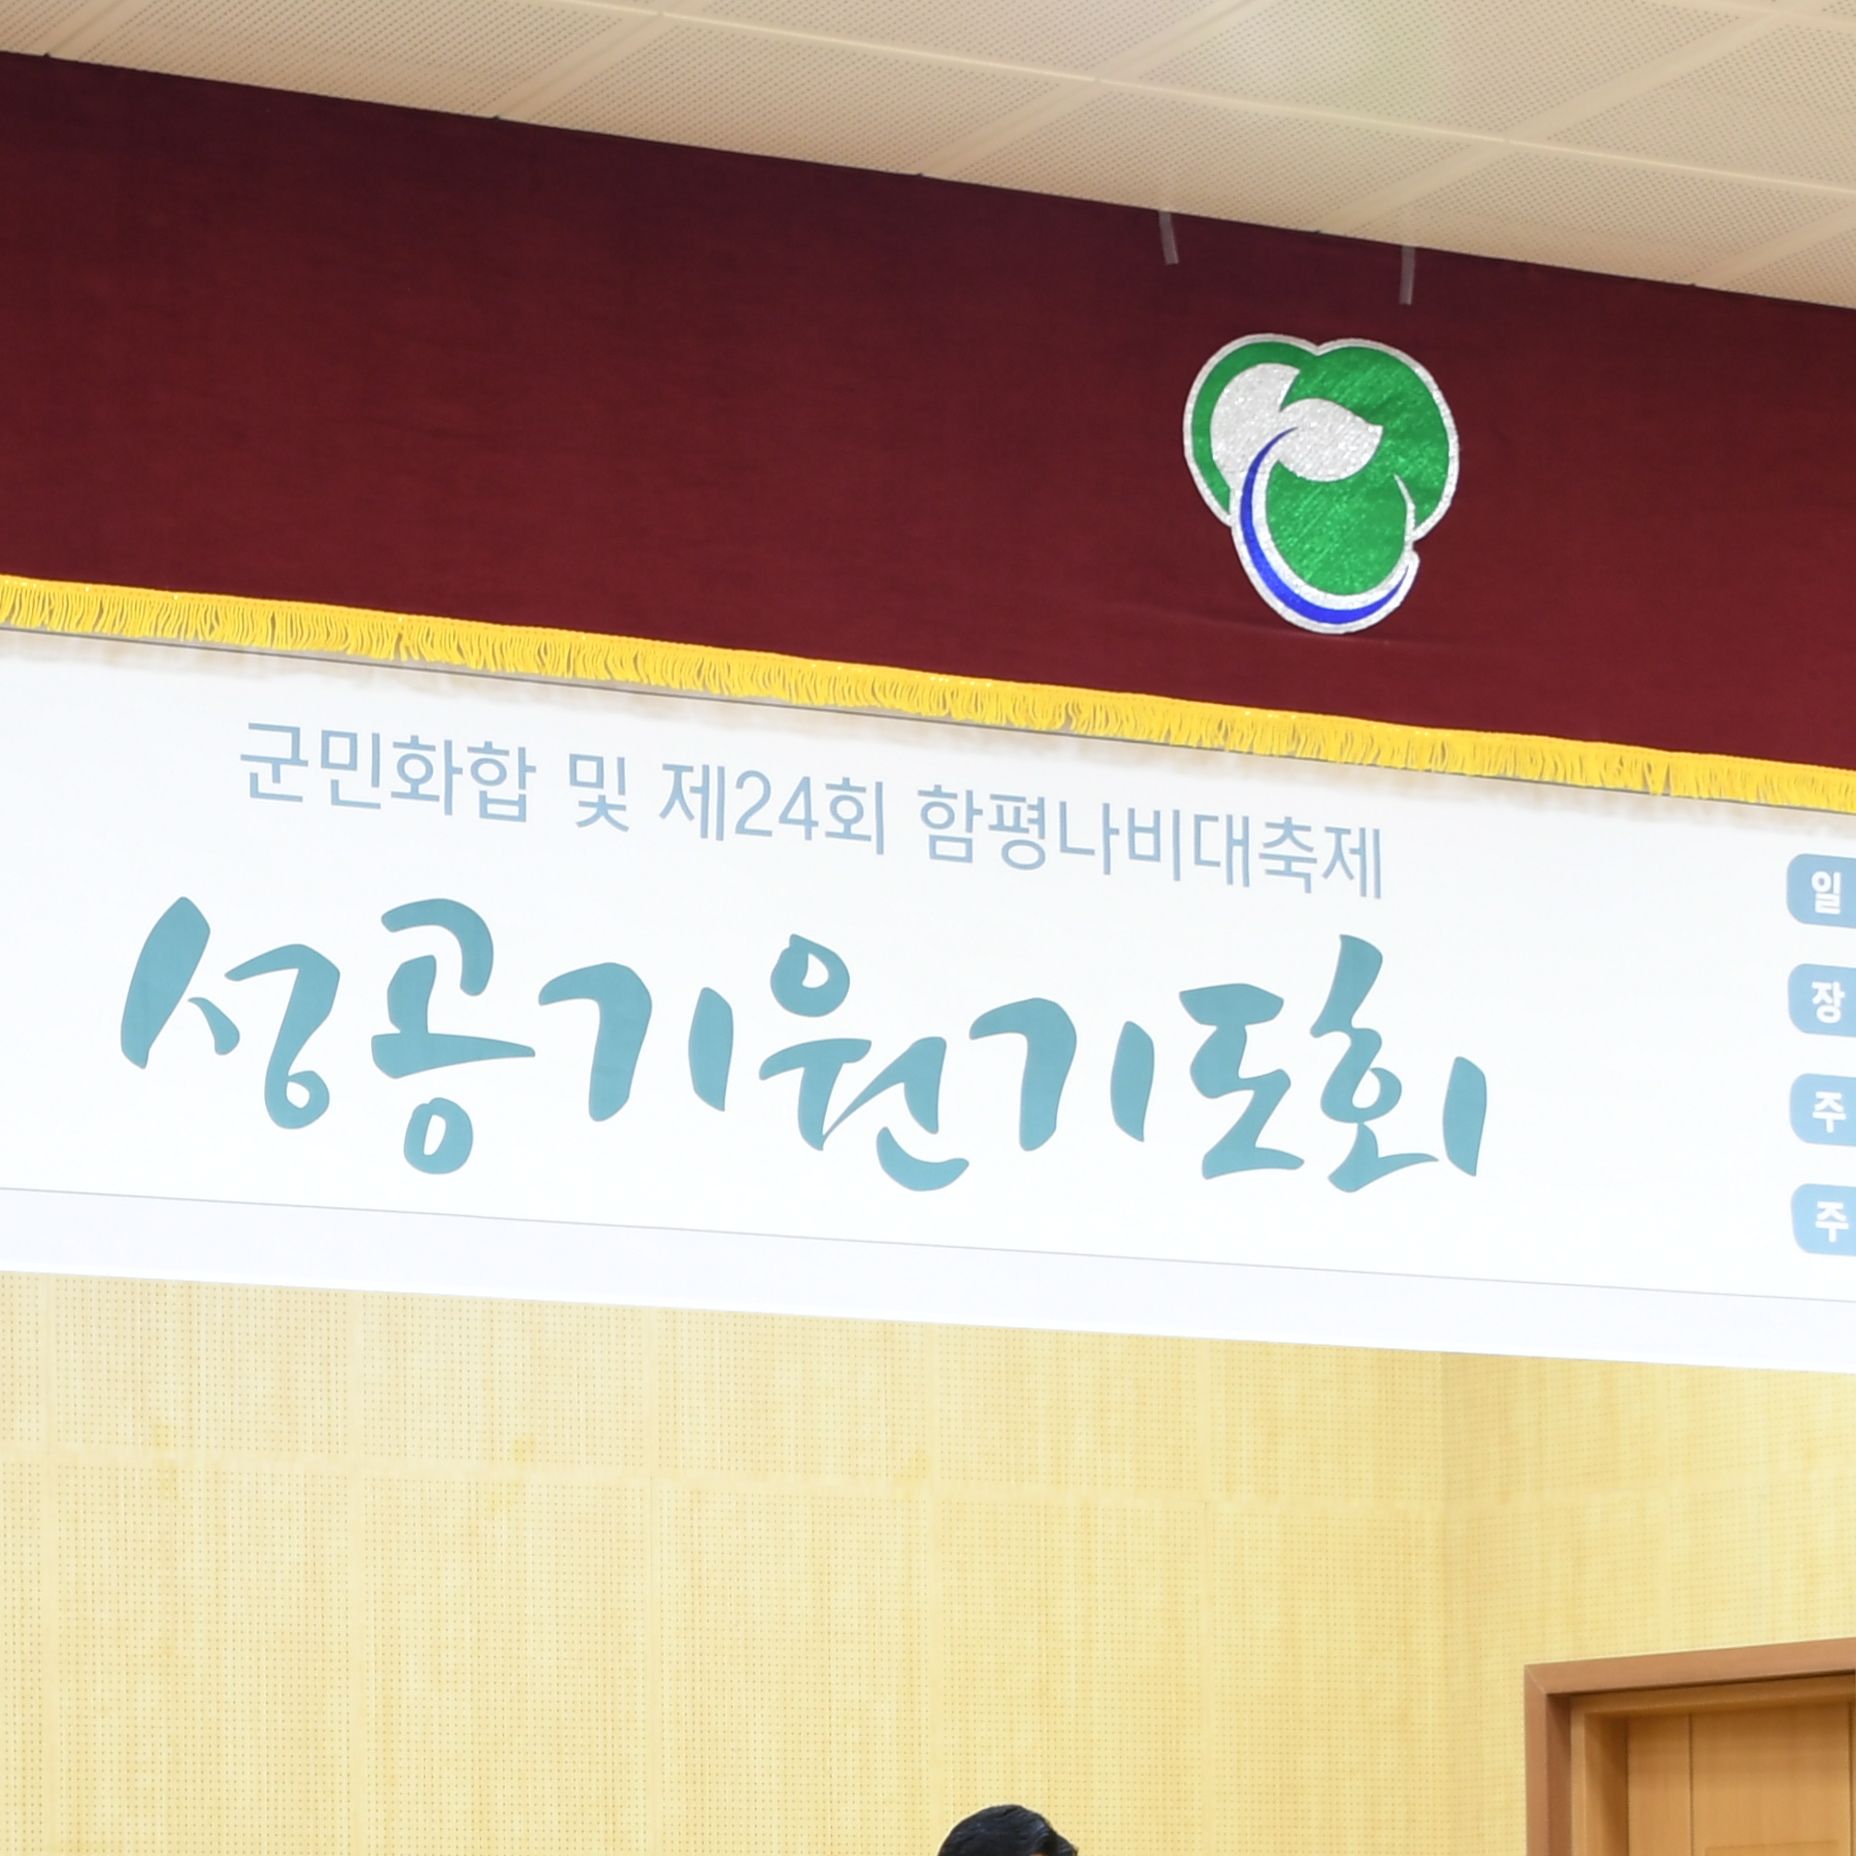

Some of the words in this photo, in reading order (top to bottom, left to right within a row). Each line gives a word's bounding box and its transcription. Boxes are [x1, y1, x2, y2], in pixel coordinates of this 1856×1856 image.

[239, 722, 537, 823] 군민화합
[568, 753, 630, 832] 및
[659, 763, 886, 856] 제24회
[917, 781, 1384, 900] 함평나비대축제
[120, 895, 1488, 1193] 성공기원기도회
